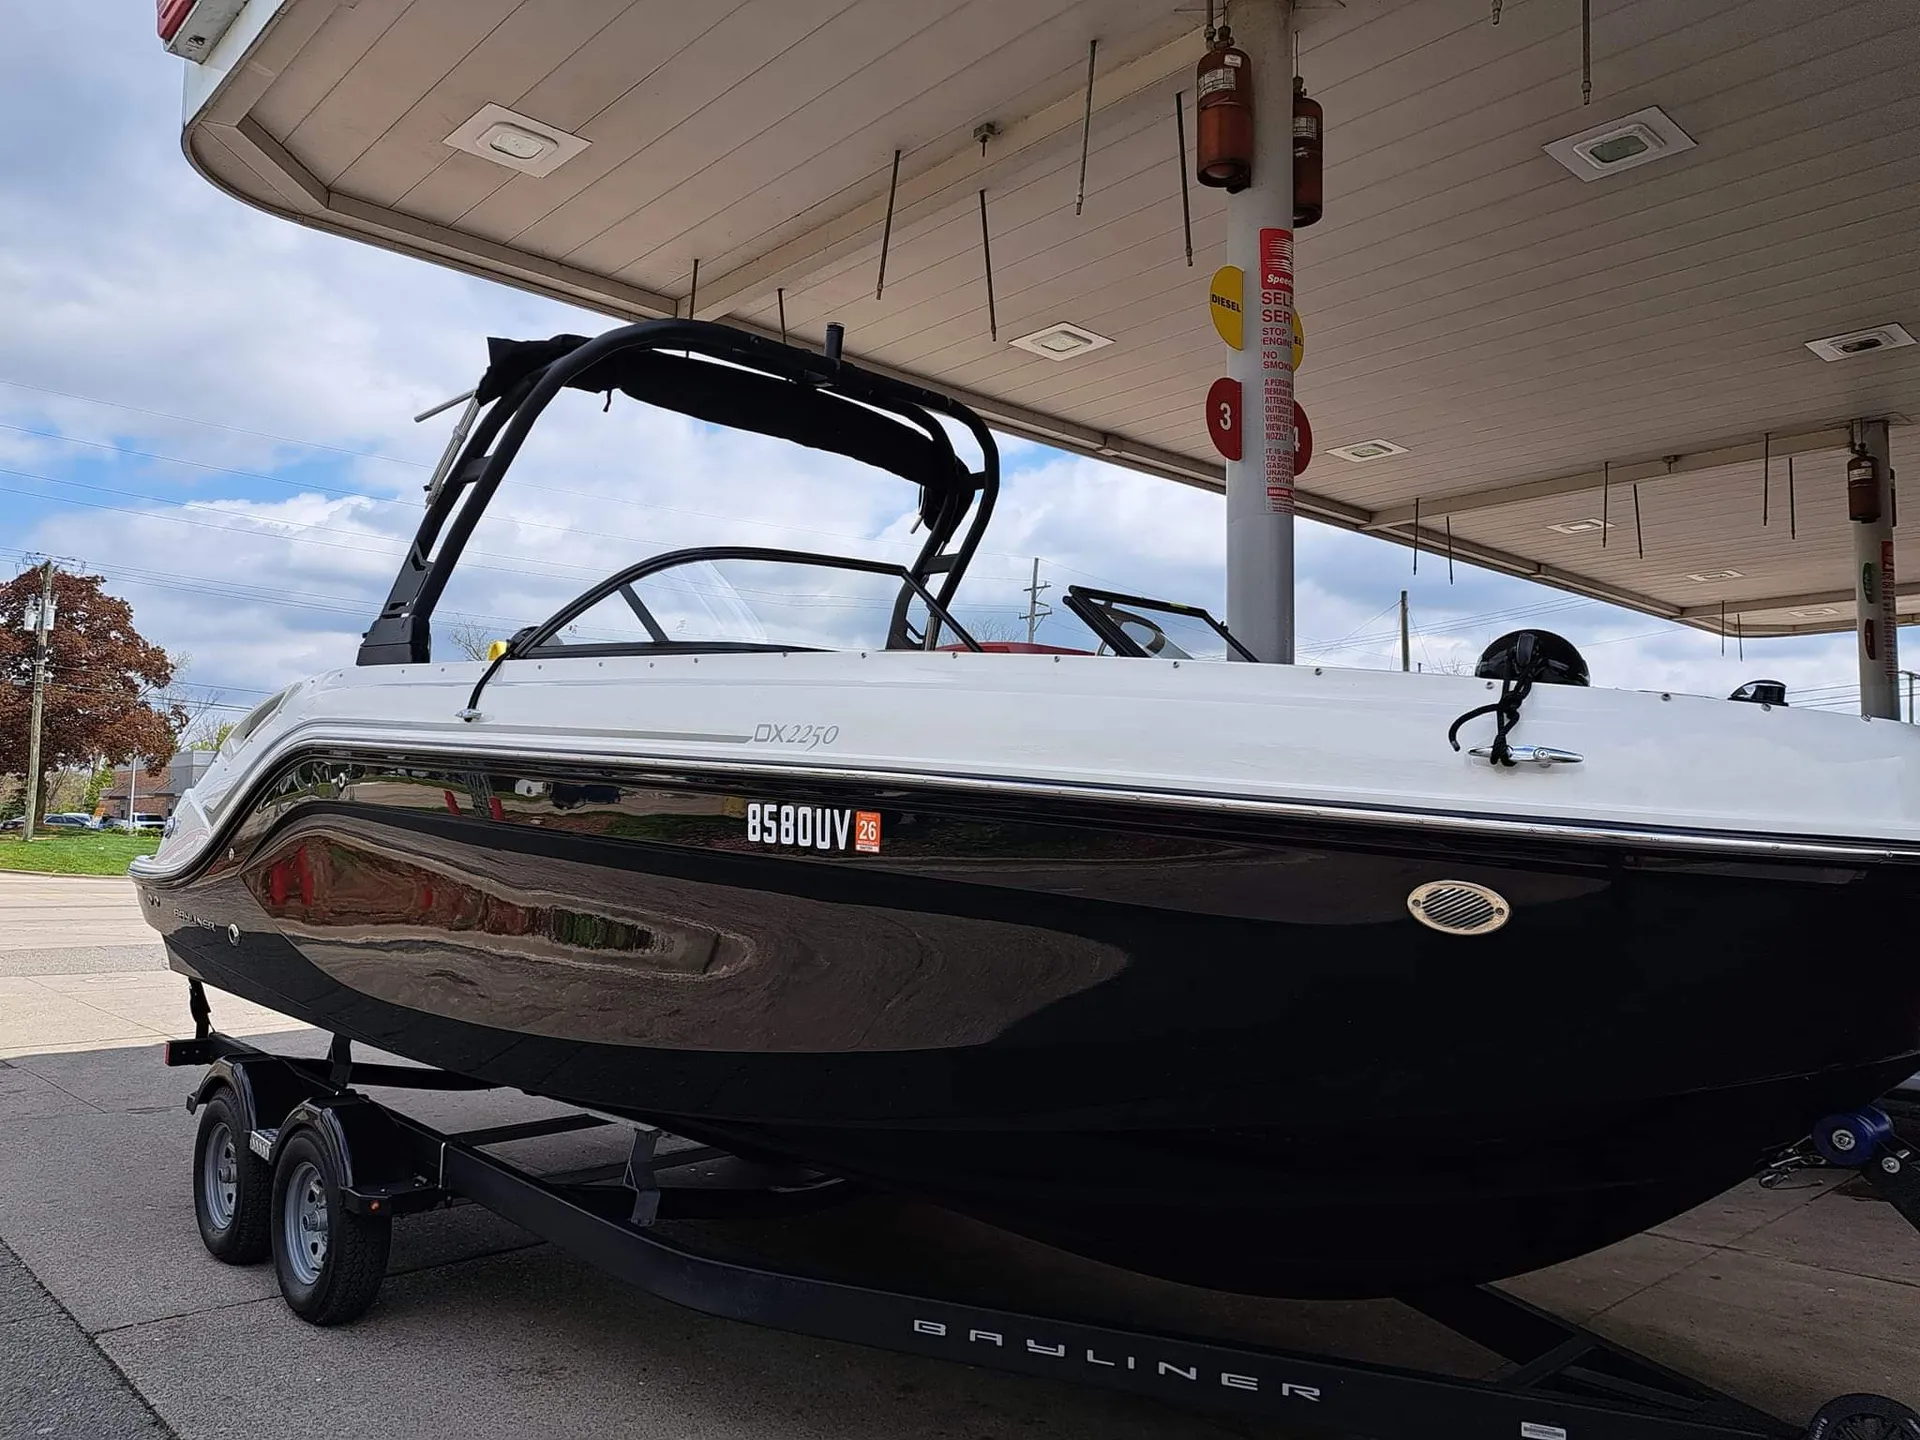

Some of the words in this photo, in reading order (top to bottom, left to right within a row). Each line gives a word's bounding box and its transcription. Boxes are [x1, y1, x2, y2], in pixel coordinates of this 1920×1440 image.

[1211, 293, 1241, 313] DIESEL
[1262, 309, 1293, 325] SER
[1262, 327, 1287, 337] STOP
[1262, 337, 1292, 349] ENGINE
[1263, 351, 1278, 359] NO
[1220, 402, 1232, 431] 3
[748, 803, 850, 850] 8580UV
[859, 820, 877, 840] 26
[914, 1319, 1320, 1401] BAYLINER
